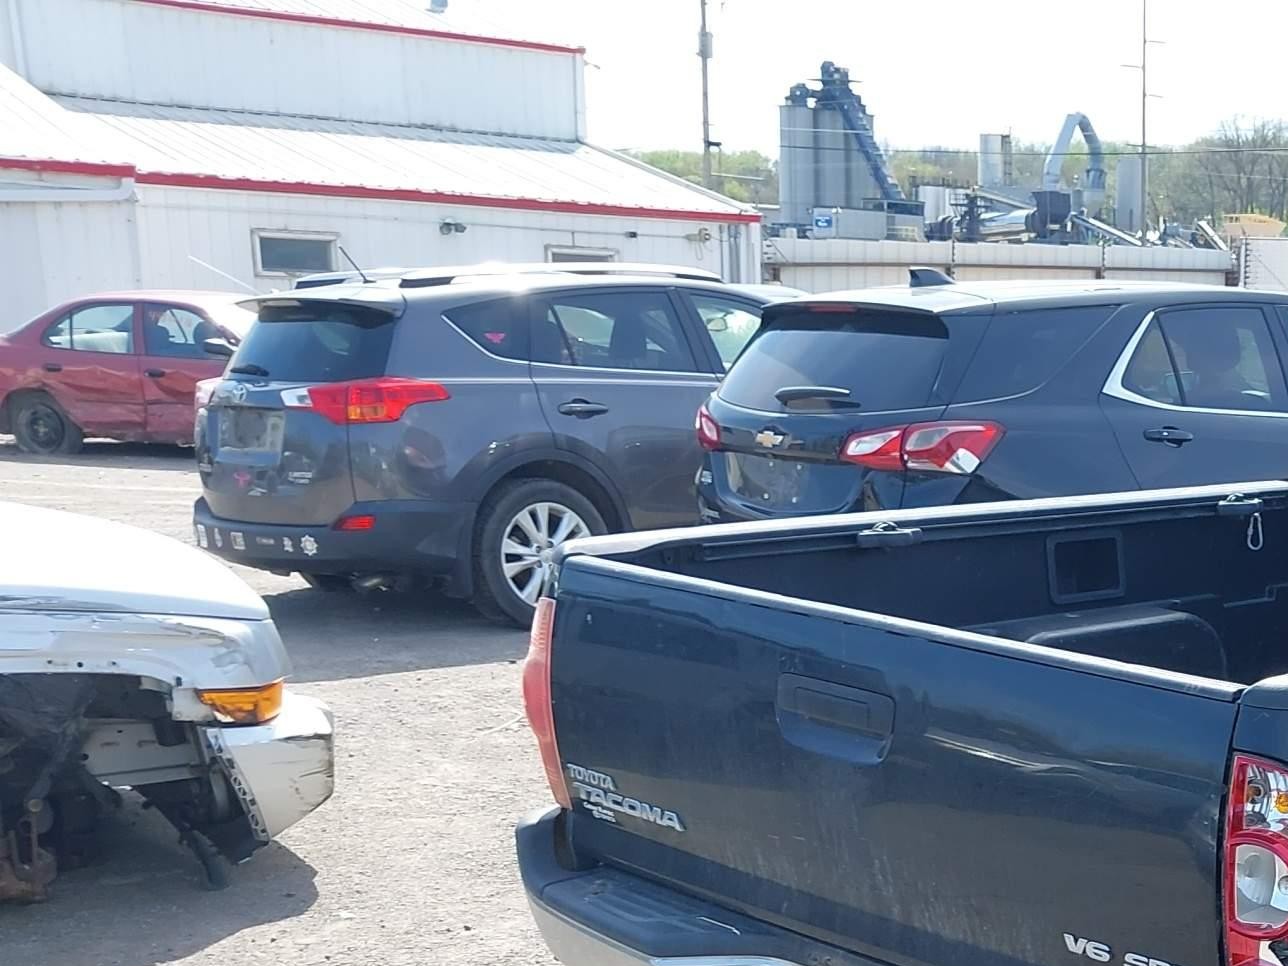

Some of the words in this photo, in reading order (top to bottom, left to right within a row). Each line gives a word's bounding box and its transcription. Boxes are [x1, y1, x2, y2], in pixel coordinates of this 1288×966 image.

[566, 763, 617, 791] TOYOTA
[572, 781, 686, 832] TACOMA
[1063, 933, 1110, 962] V6
